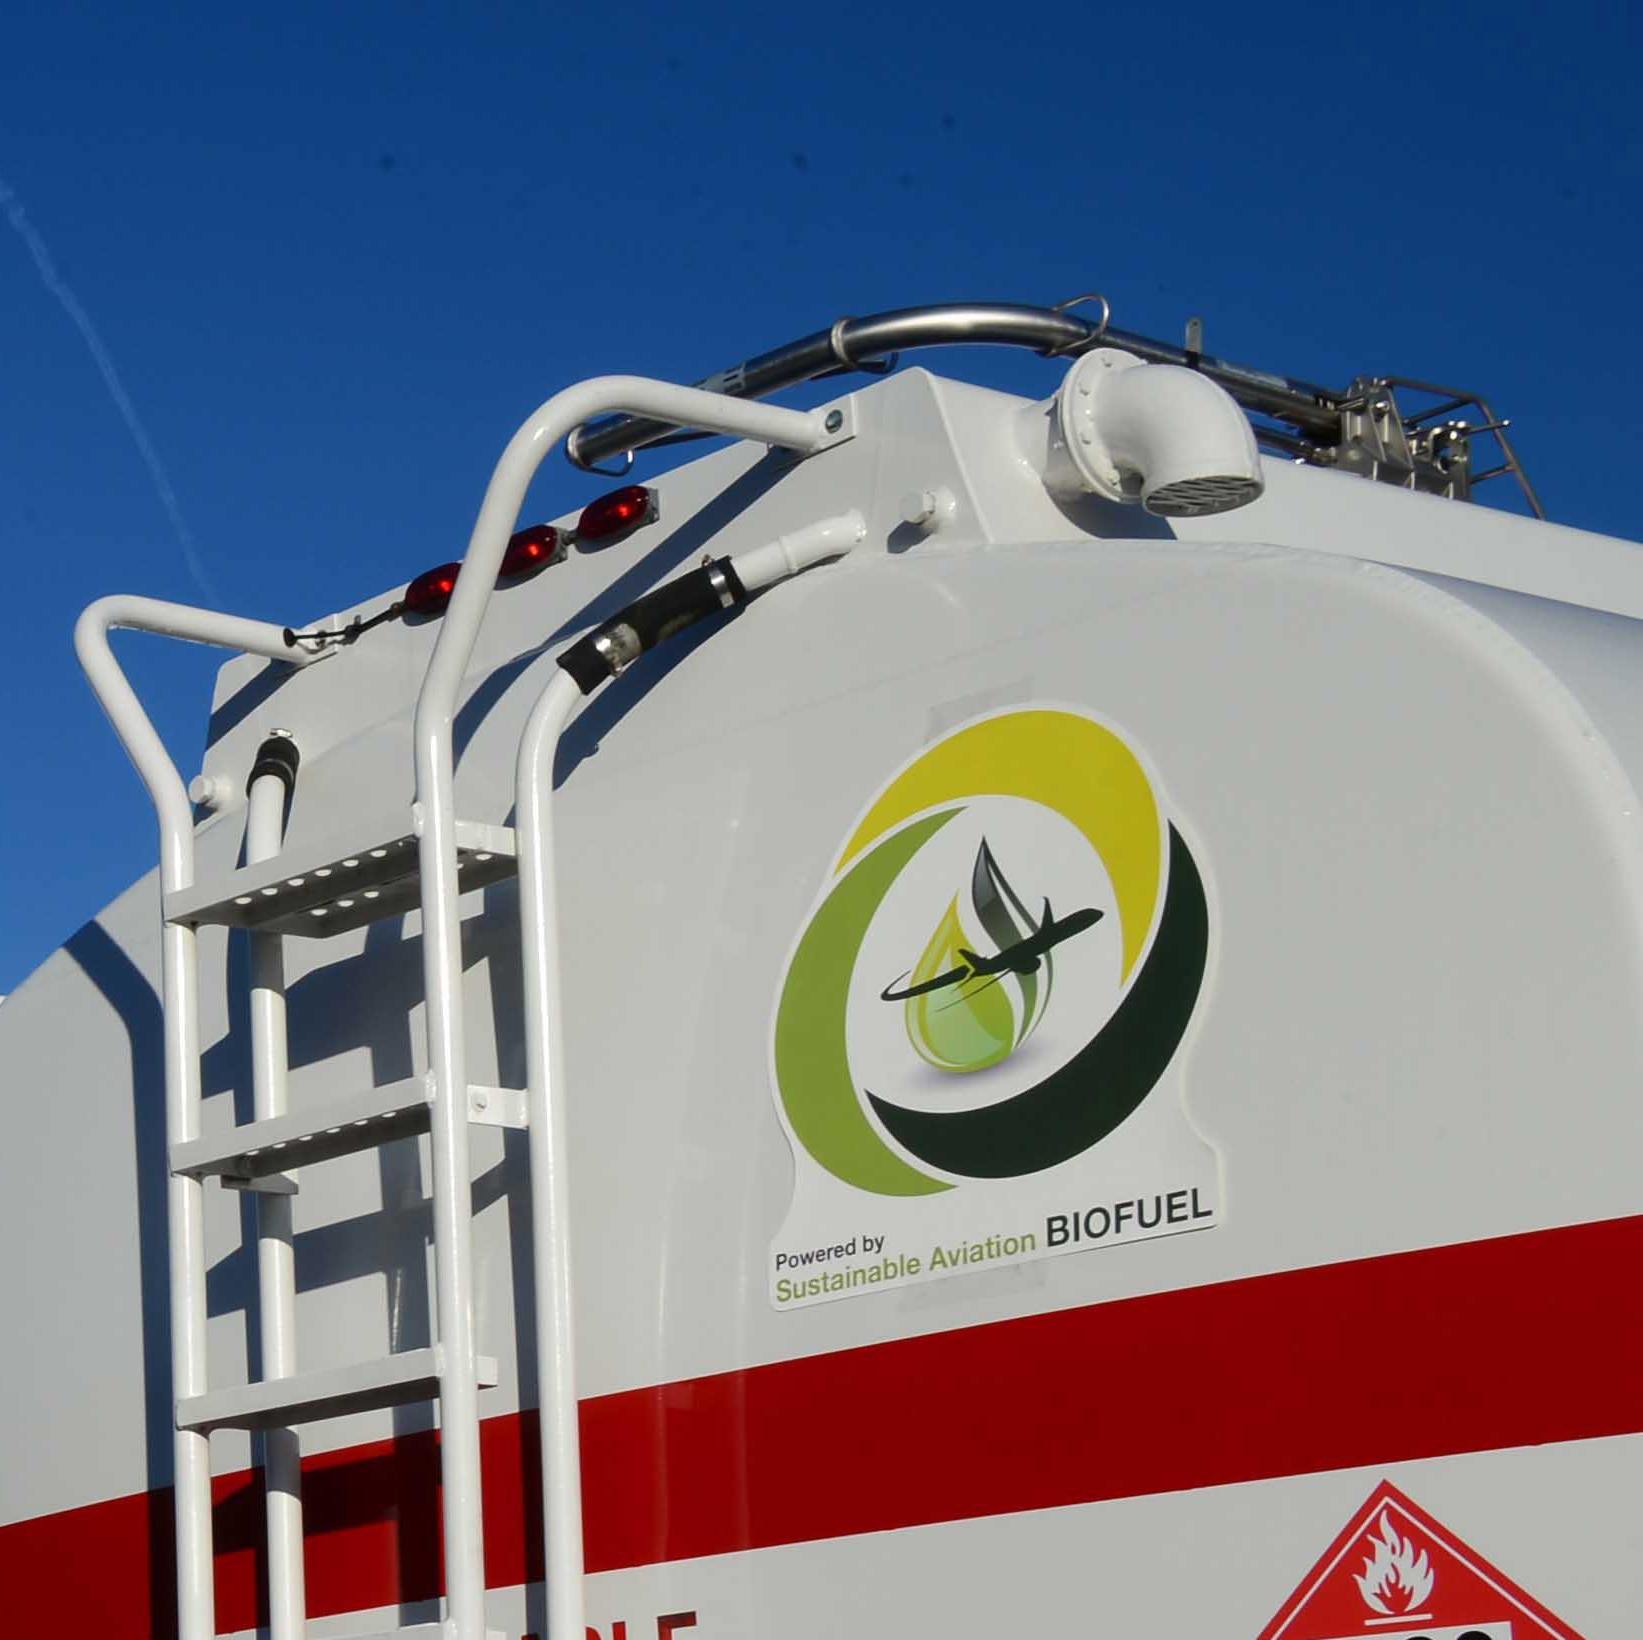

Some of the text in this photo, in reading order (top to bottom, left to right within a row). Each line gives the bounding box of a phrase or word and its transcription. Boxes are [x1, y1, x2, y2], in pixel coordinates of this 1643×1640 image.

[775, 1234, 885, 1271] Powered by
[776, 1187, 1214, 1302] Sustainable Aviation BIOFUEL
